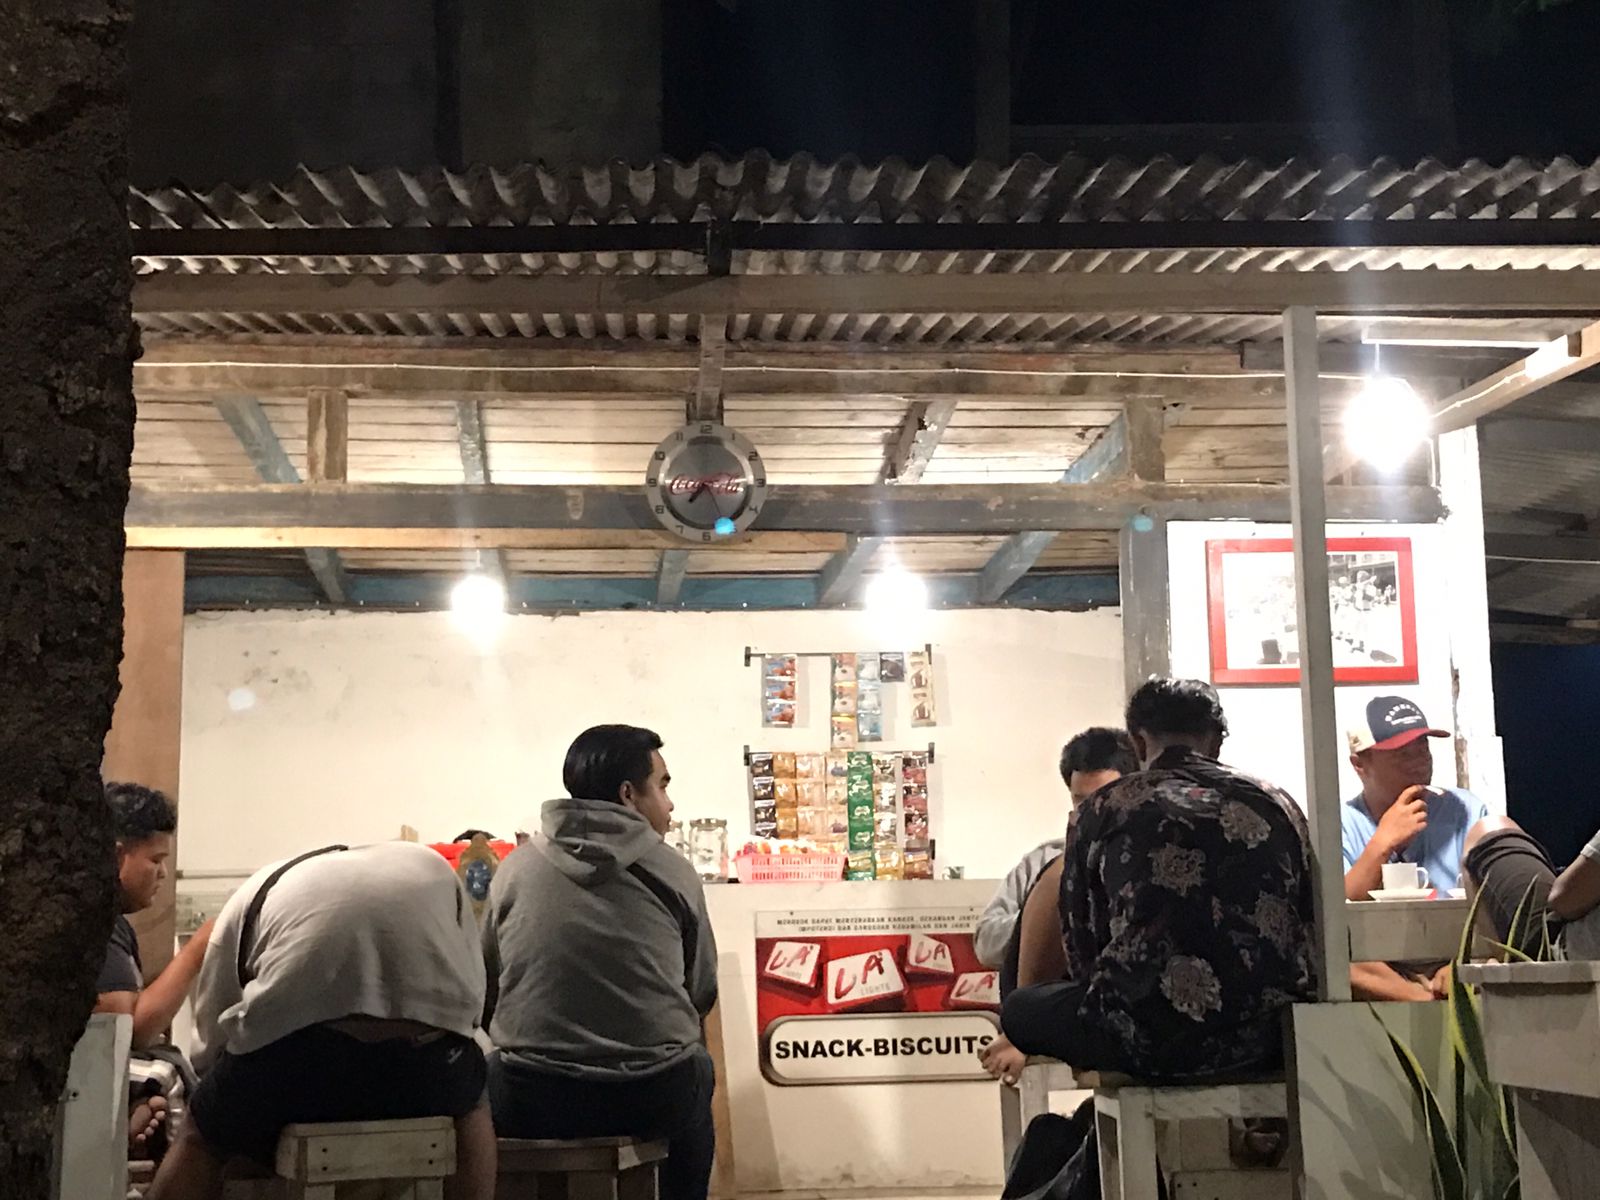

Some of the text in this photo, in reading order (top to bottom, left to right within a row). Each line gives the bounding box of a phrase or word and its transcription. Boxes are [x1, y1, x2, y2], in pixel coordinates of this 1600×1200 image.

[769, 945, 811, 970] LA
[915, 941, 946, 964] LA
[835, 954, 884, 999] LA
[955, 974, 995, 997] LA
[775, 1035, 994, 1060] SNACK-BISCUITS
